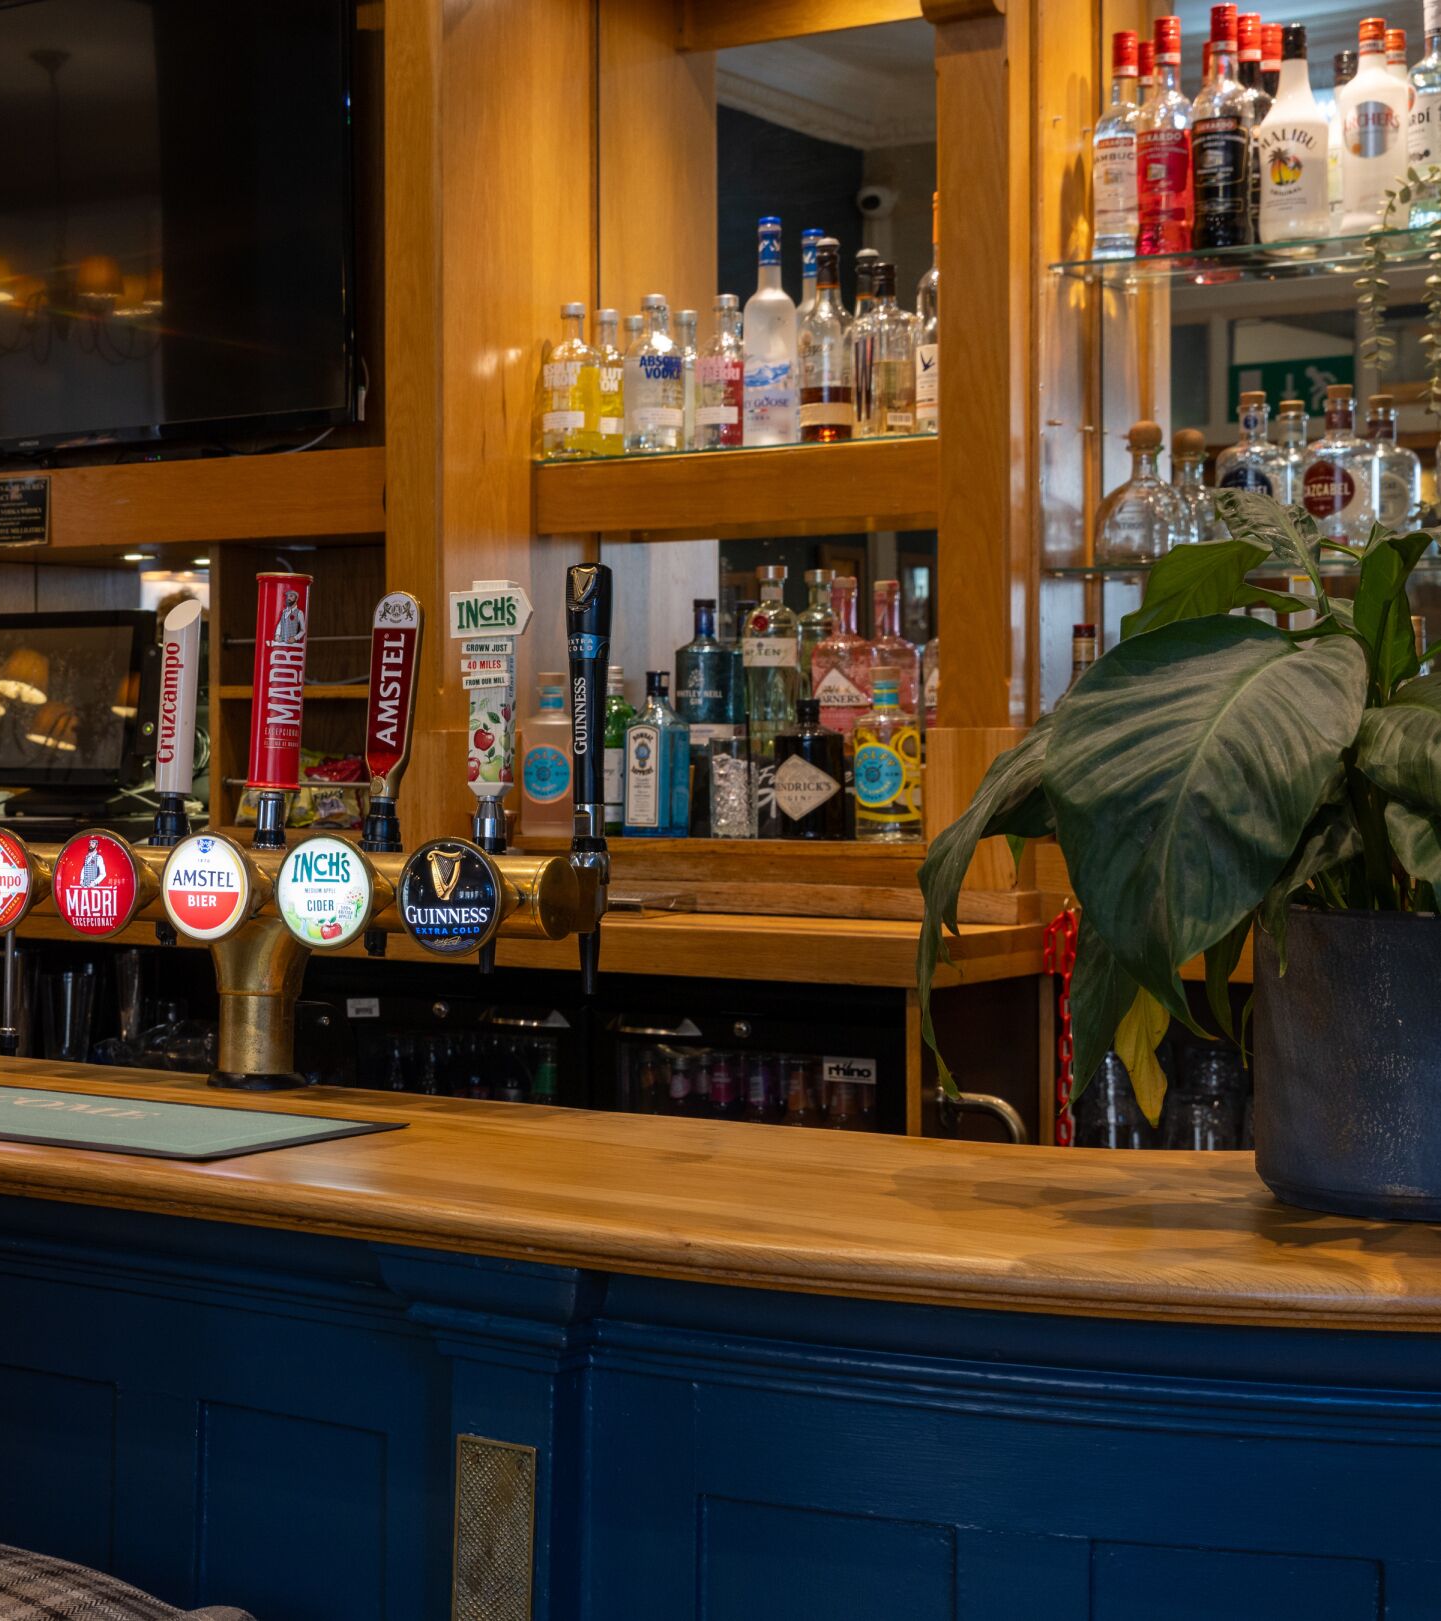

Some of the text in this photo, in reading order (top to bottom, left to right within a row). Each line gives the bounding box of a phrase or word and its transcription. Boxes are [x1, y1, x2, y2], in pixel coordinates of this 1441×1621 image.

[1260, 128, 1317, 150] MALIBU
[466, 644, 508, 652] GROWN JUST
[467, 660, 501, 670] 40 MILES
[465, 676, 505, 686] FROM OUR MILL
[376, 633, 406, 747] AMSTEL
[157, 642, 184, 764] Cruzcampo
[574, 677, 588, 755] GUINNESS
[172, 869, 234, 888] AMSTEL
[66, 886, 117, 916] MADRÍ
[187, 894, 217, 907] BIER
[307, 899, 335, 912] CIDER
[72, 917, 114, 927] EXCEPCIONAL
[406, 905, 488, 924] GUINNESS
[416, 927, 481, 935] EXTRA COLD
[828, 1061, 871, 1078] rhino
